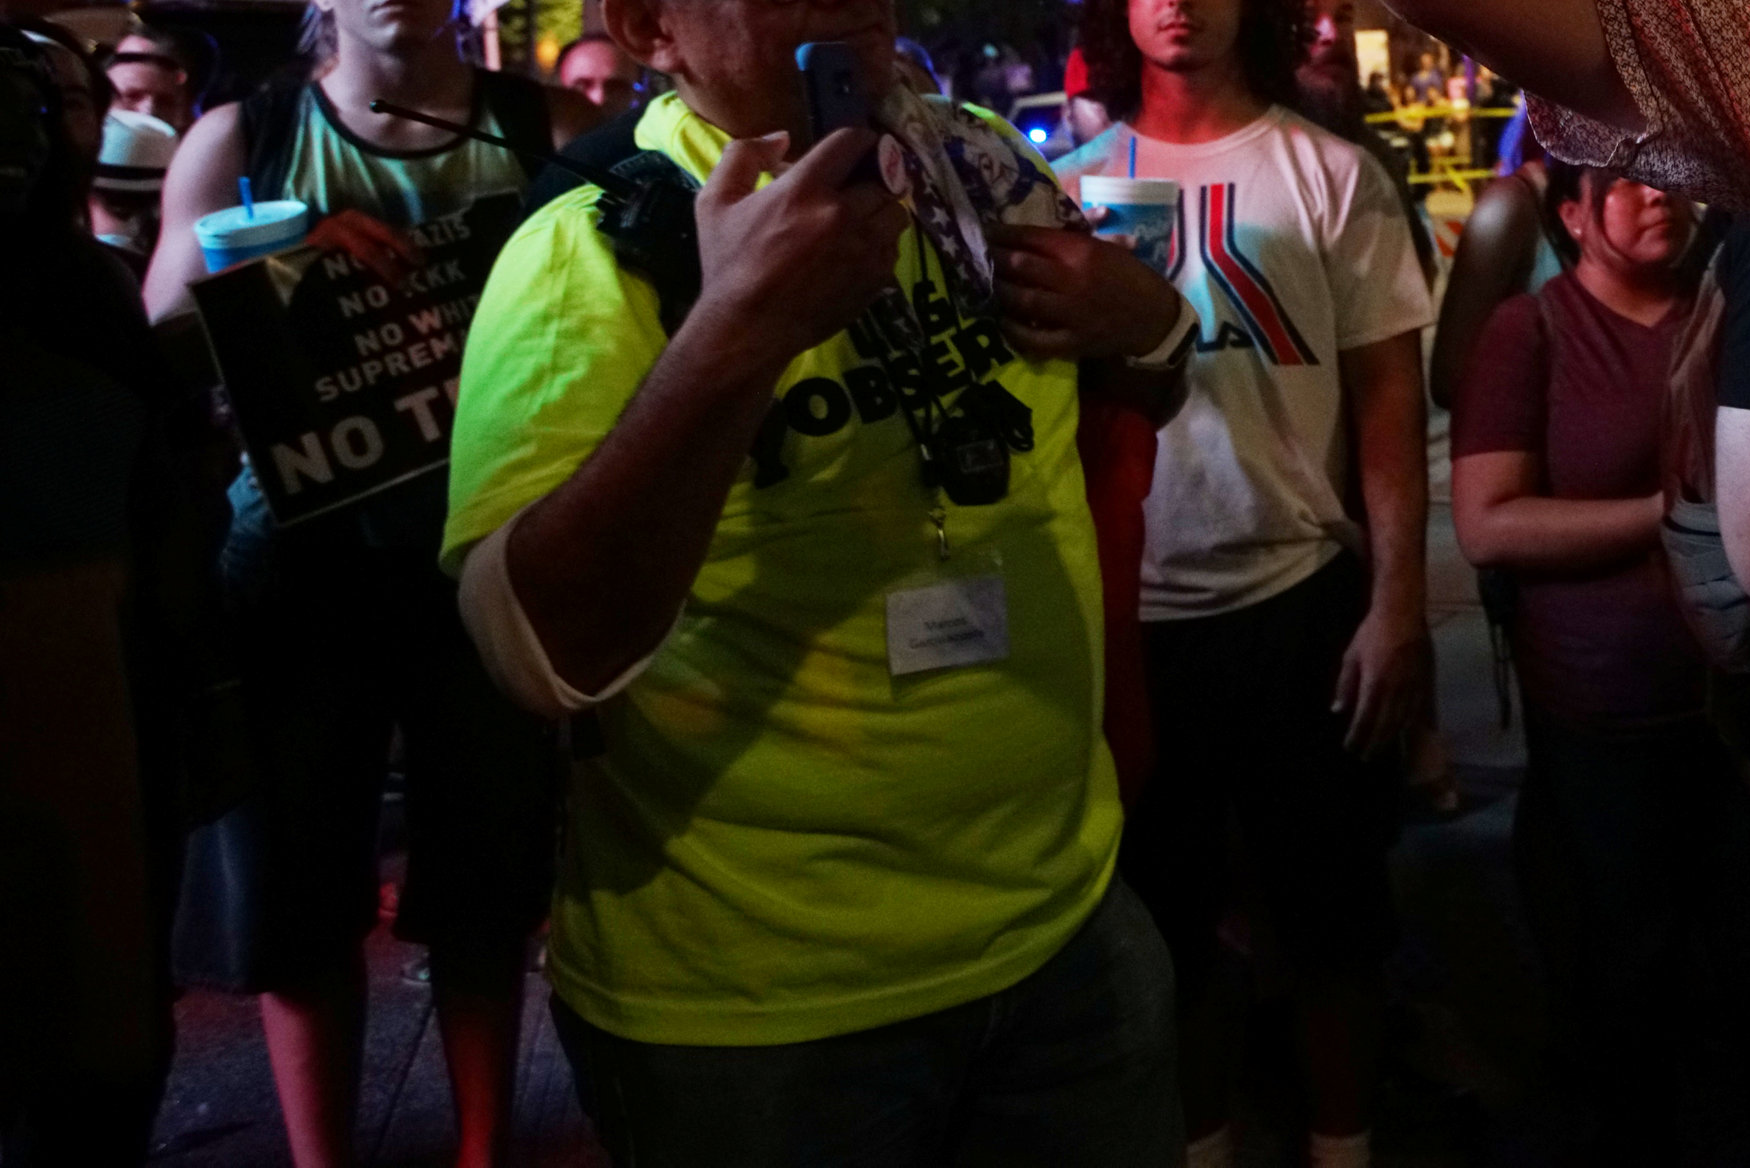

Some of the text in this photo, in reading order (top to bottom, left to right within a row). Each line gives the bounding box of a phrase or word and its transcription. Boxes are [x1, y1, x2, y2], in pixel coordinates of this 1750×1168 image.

[410, 214, 472, 248] AZIS
[337, 283, 391, 319] NO
[353, 292, 481, 358] NO WHIT
[313, 332, 464, 403] SUPREM
[269, 414, 386, 496] NO
